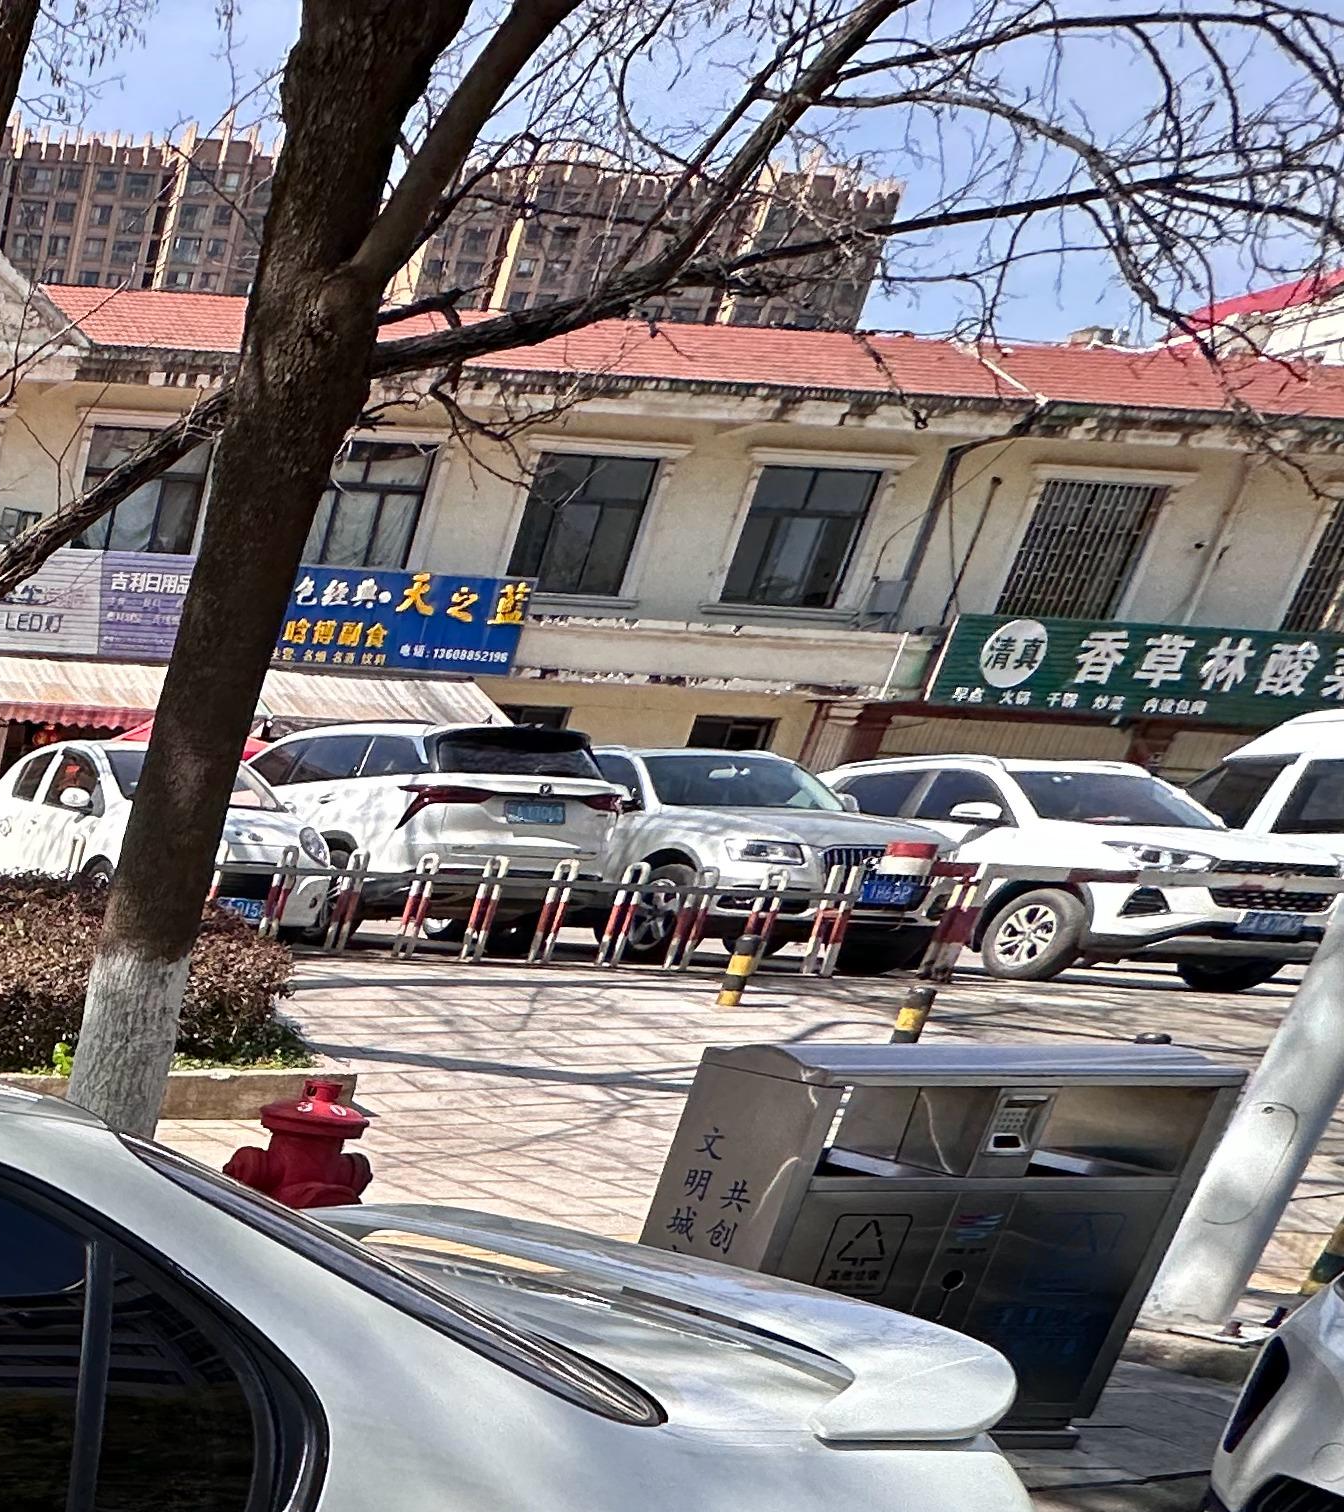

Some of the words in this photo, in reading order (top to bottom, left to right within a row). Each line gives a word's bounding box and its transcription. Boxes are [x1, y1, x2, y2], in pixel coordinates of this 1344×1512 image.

[984, 636, 1046, 671] 清真
[666, 1126, 725, 1252] 文明城
